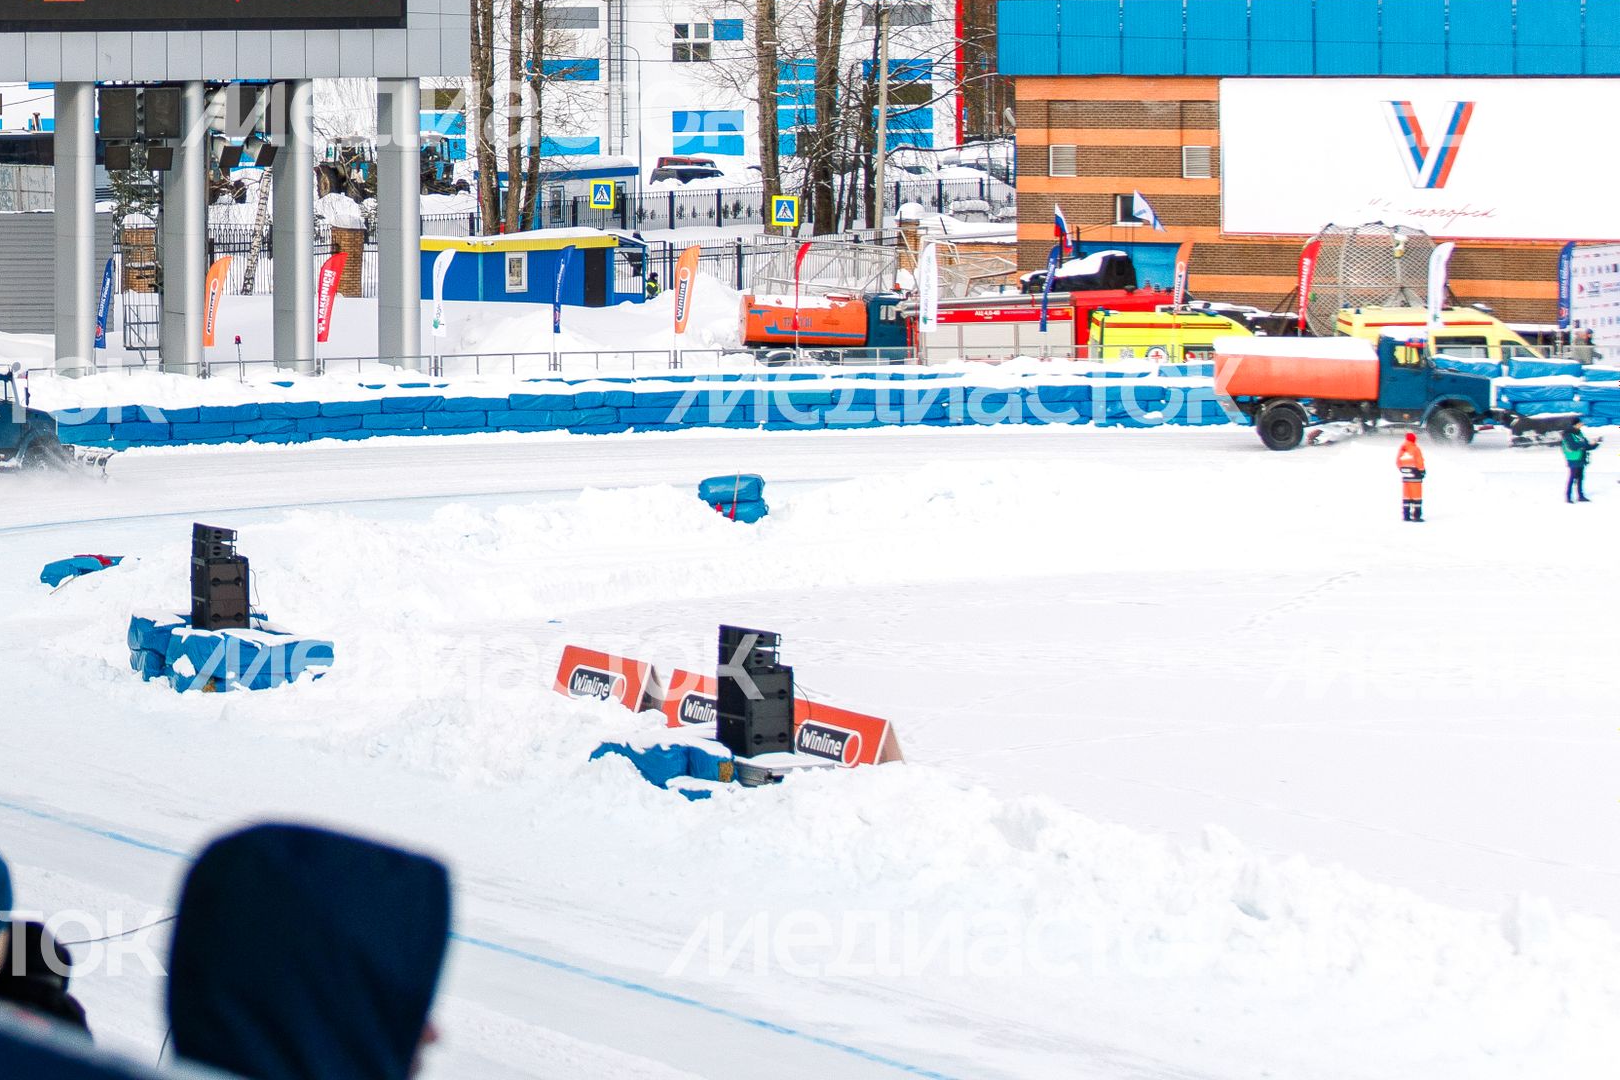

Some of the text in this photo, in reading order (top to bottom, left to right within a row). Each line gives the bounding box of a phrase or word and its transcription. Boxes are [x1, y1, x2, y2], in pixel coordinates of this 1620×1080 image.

[573, 672, 610, 697] Winline
[684, 698, 717, 722] Winlin
[801, 728, 843, 756] Winline
